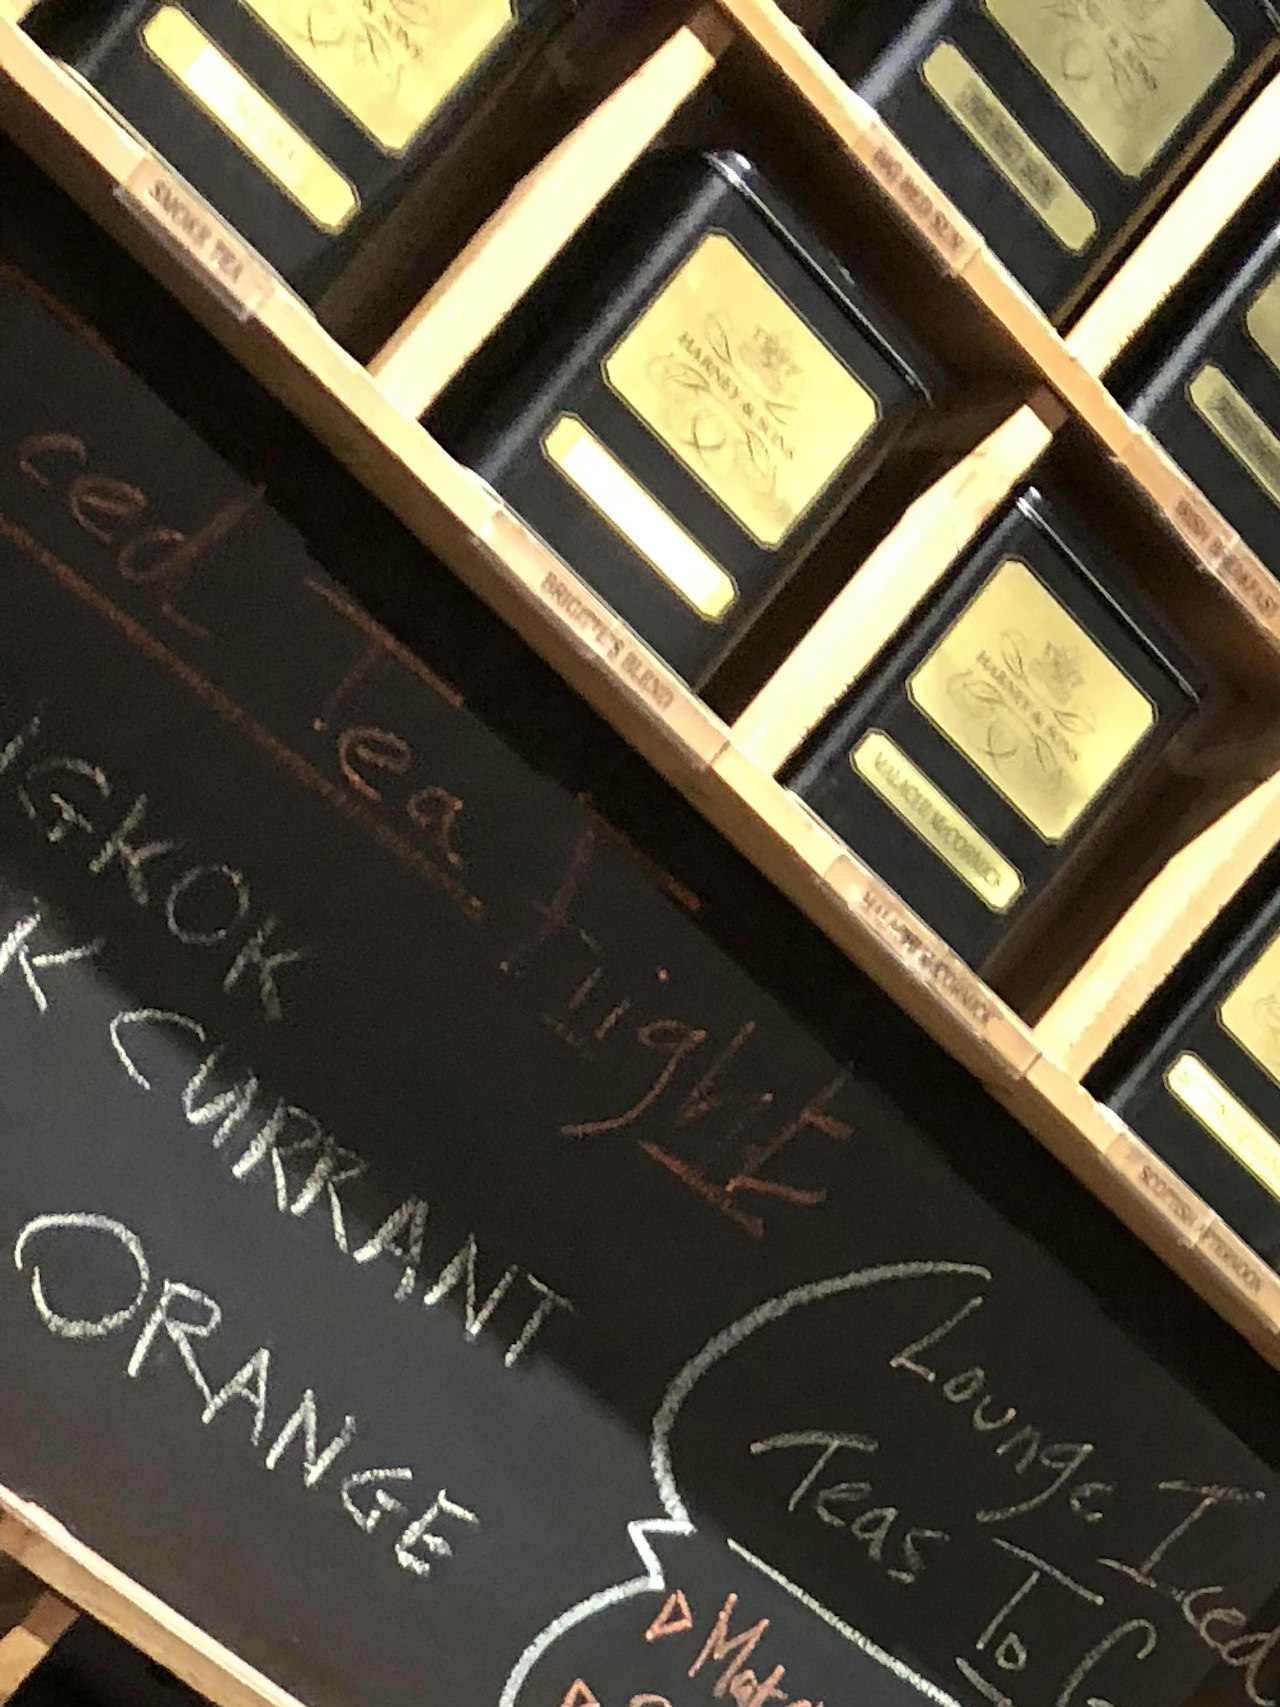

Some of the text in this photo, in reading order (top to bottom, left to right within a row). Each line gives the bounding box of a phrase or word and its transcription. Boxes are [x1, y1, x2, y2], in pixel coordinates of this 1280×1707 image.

[674, 330, 742, 404] HARNEY
[20, 430, 263, 640] ced
[308, 573, 464, 865] Tea
[618, 650, 678, 712] BLEND
[973, 647, 1034, 714] HARNEY
[115, 995, 573, 1371] CURRANT
[5, 1199, 482, 1585] ORANGE
[890, 1296, 1104, 1520] Lounge
[751, 1439, 951, 1590] Teas
[976, 1539, 1104, 1675] To
